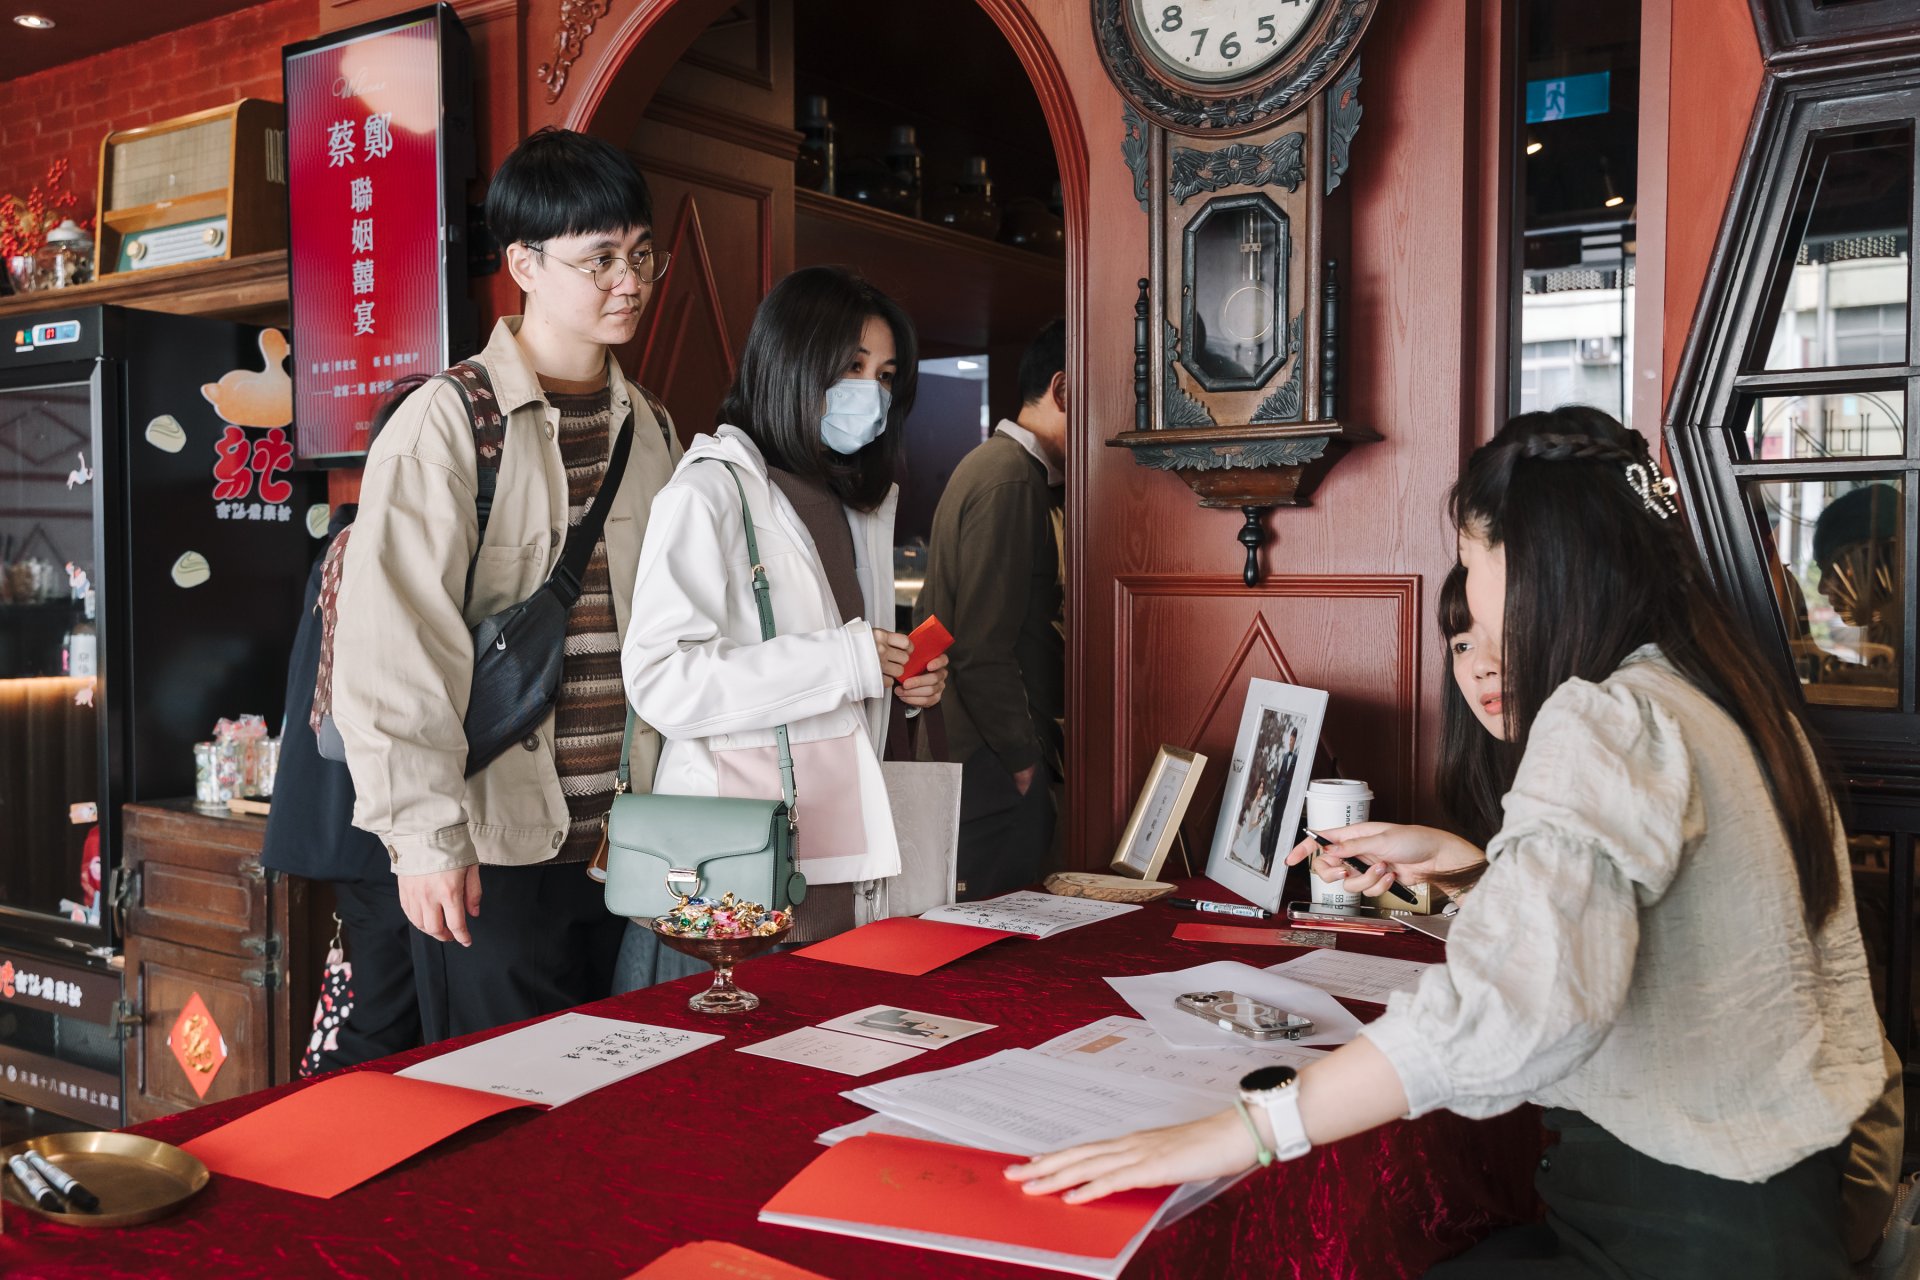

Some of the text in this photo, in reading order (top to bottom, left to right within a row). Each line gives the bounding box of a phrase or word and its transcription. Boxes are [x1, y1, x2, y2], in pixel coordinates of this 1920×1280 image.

[1161, 5, 1183, 32] 8
[1255, 14, 1275, 44] 5
[1190, 28, 1209, 56] 7
[1219, 31, 1242, 60] 6
